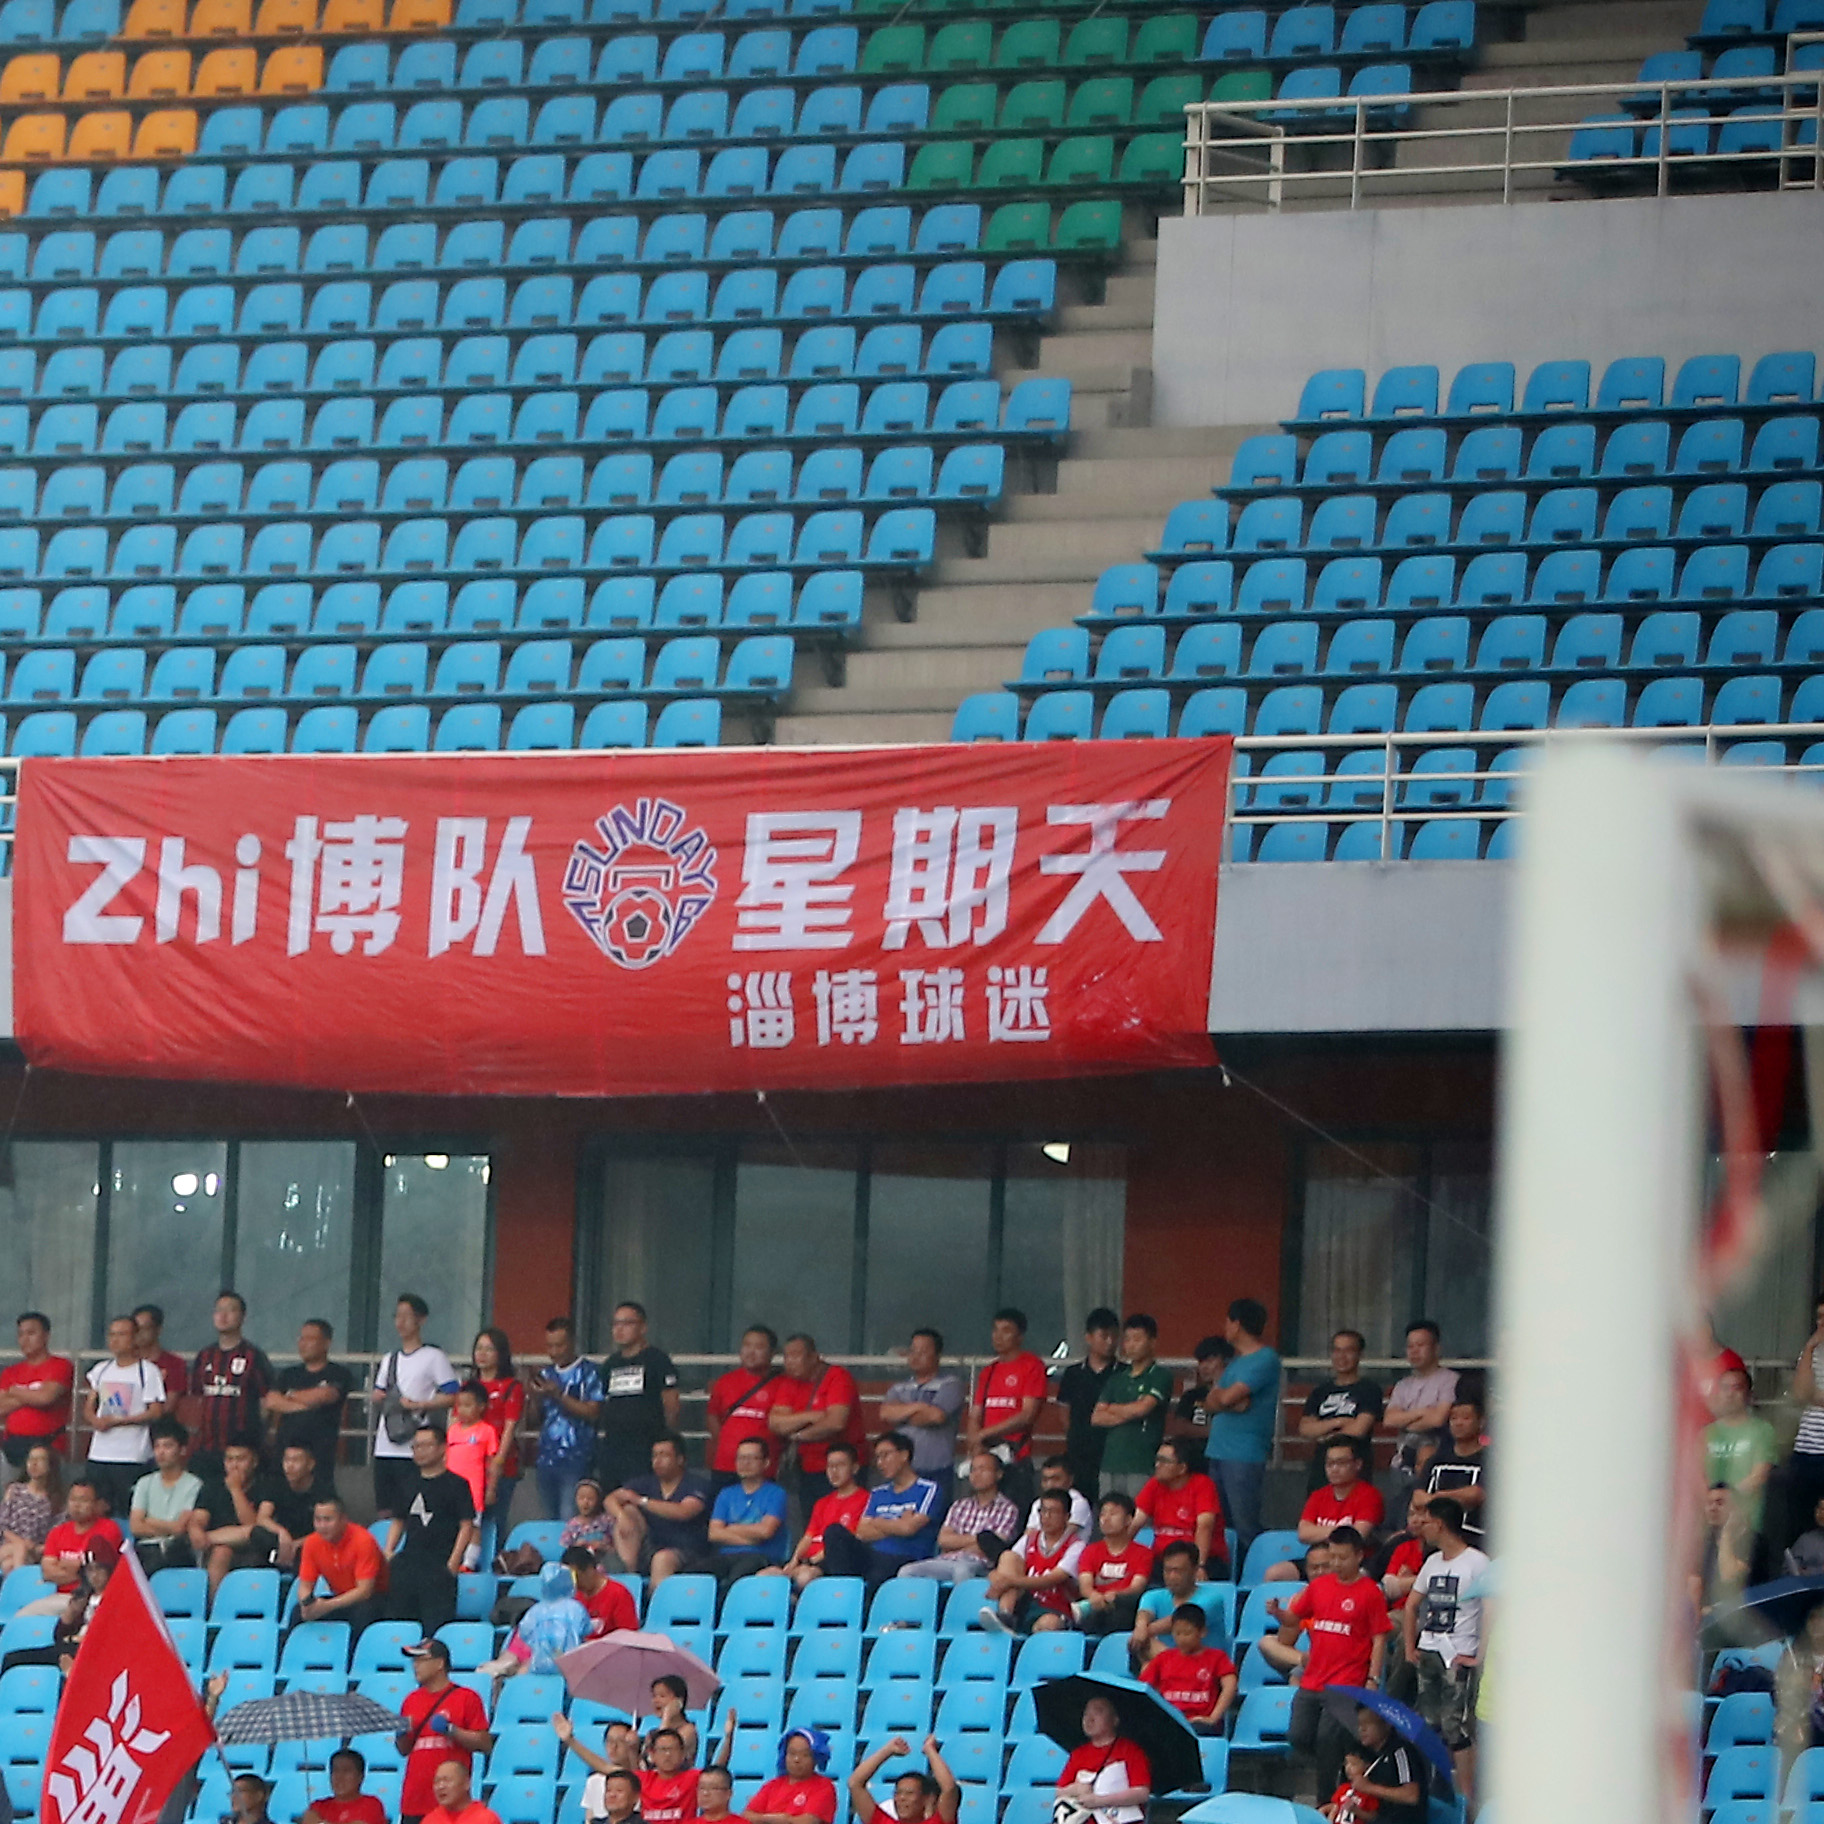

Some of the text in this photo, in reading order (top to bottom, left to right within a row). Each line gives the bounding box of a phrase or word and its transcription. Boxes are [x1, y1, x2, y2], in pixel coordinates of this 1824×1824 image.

[732, 799, 1171, 953] 星期天
[726, 963, 1052, 1050] 淄博球迷
